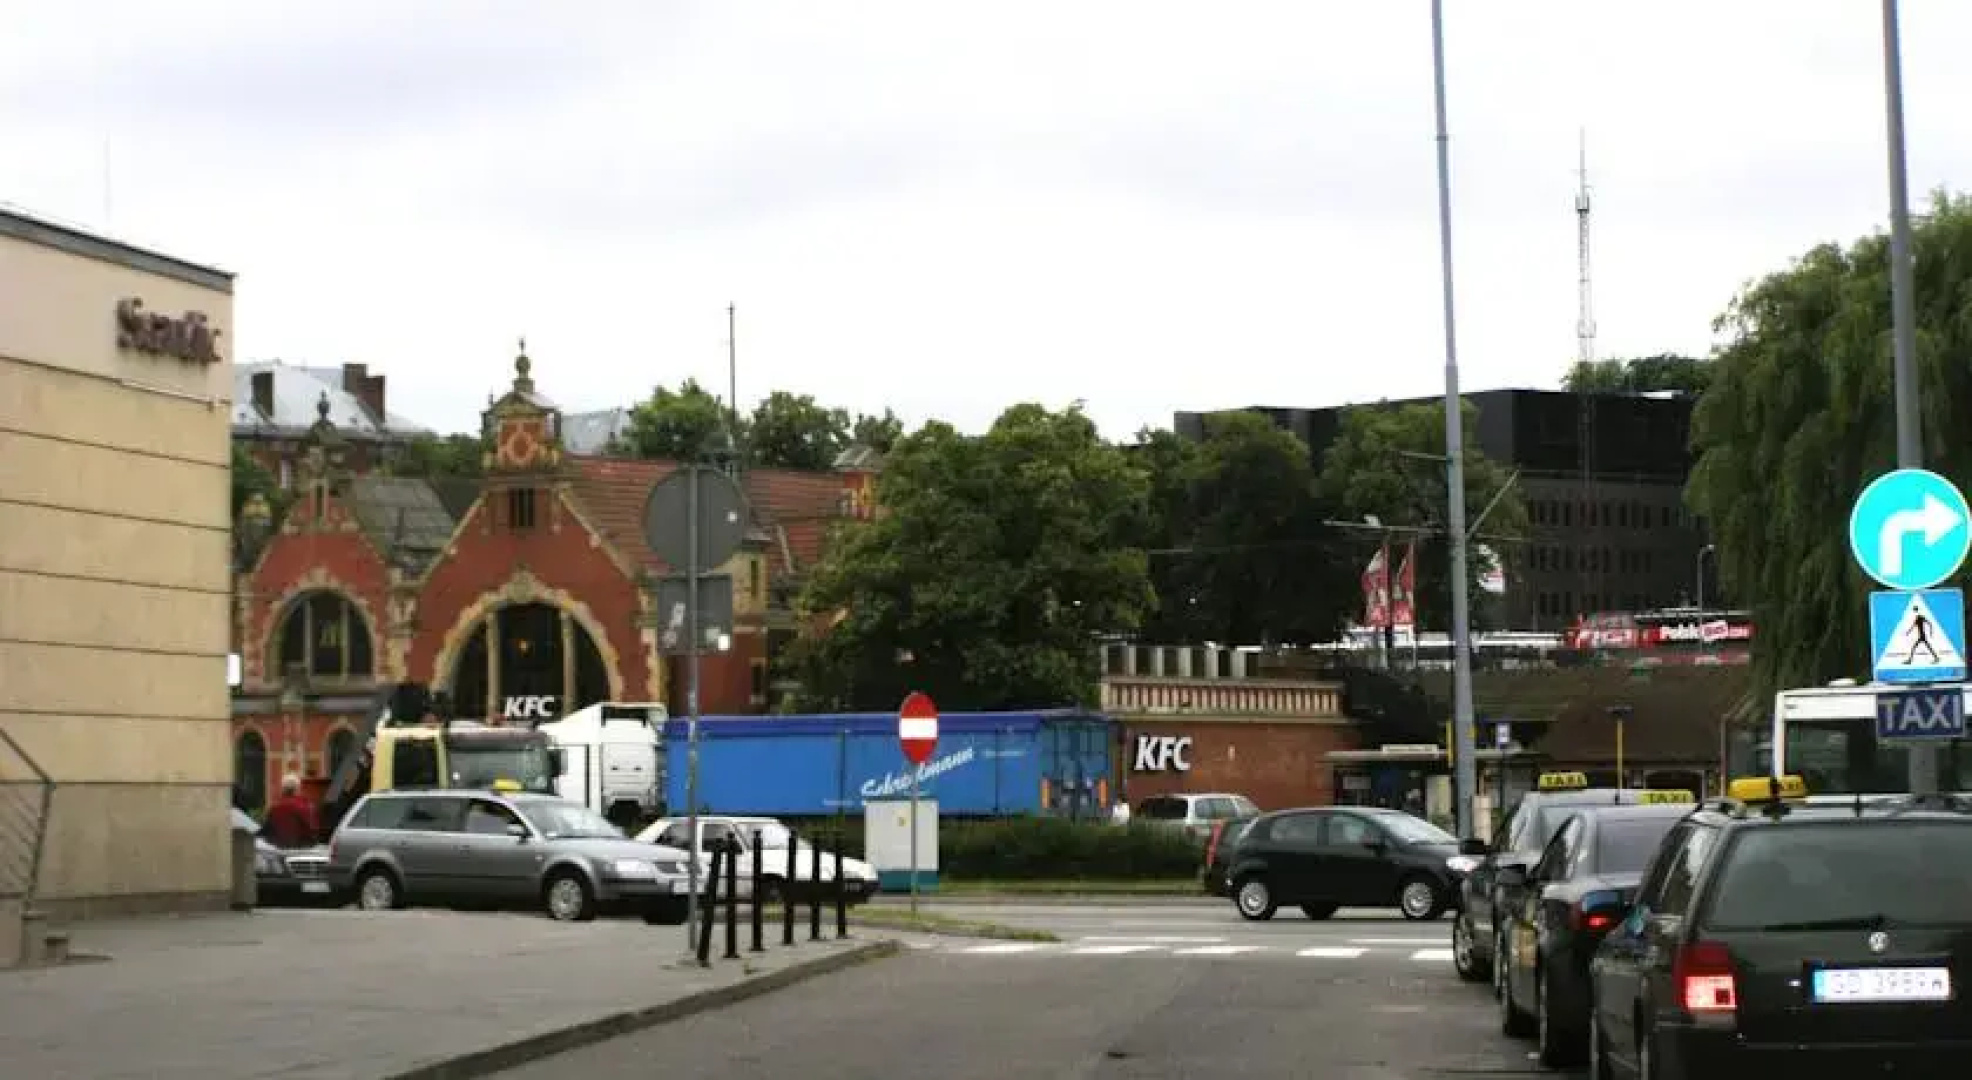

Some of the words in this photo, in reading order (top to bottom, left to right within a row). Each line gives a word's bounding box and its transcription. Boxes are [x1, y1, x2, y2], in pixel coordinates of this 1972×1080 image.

[505, 695, 555, 717] KFC
[1878, 695, 1962, 731] TAXI
[1134, 735, 1193, 770] KFC
[1544, 774, 1583, 786] TAXI
[1646, 792, 1689, 803] TAXI
